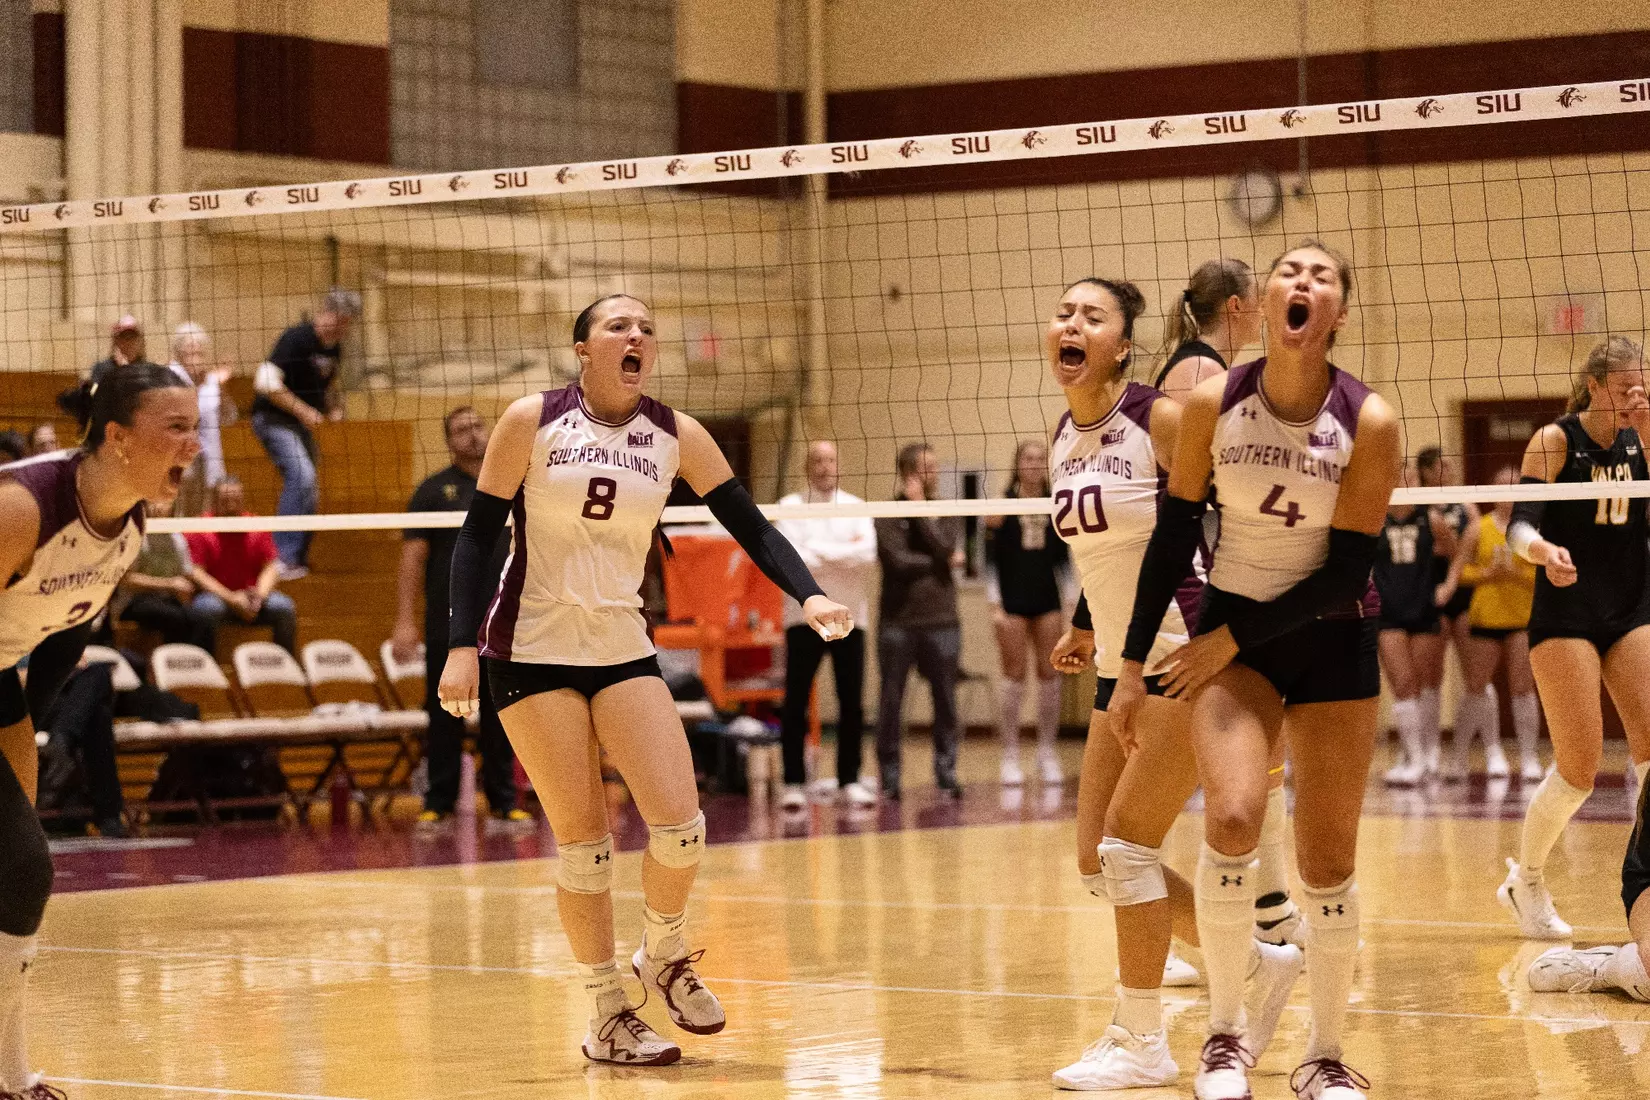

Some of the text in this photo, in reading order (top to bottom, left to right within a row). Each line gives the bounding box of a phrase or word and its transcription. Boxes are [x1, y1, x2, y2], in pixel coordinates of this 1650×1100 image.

[2, 82, 1650, 224] SIU SIU SIU SIU SIU SIU SIU SIU SIU SIU SIU SIU SIU SIU SI
[546, 446, 659, 482] SOUTHERN ILLINOIS
[1090, 455, 1132, 480] ILLINOIS
[1218, 444, 1292, 469] SOUTHERN
[581, 477, 617, 520] 8
[1054, 484, 1109, 538] 20
[1259, 484, 1307, 527] 4
